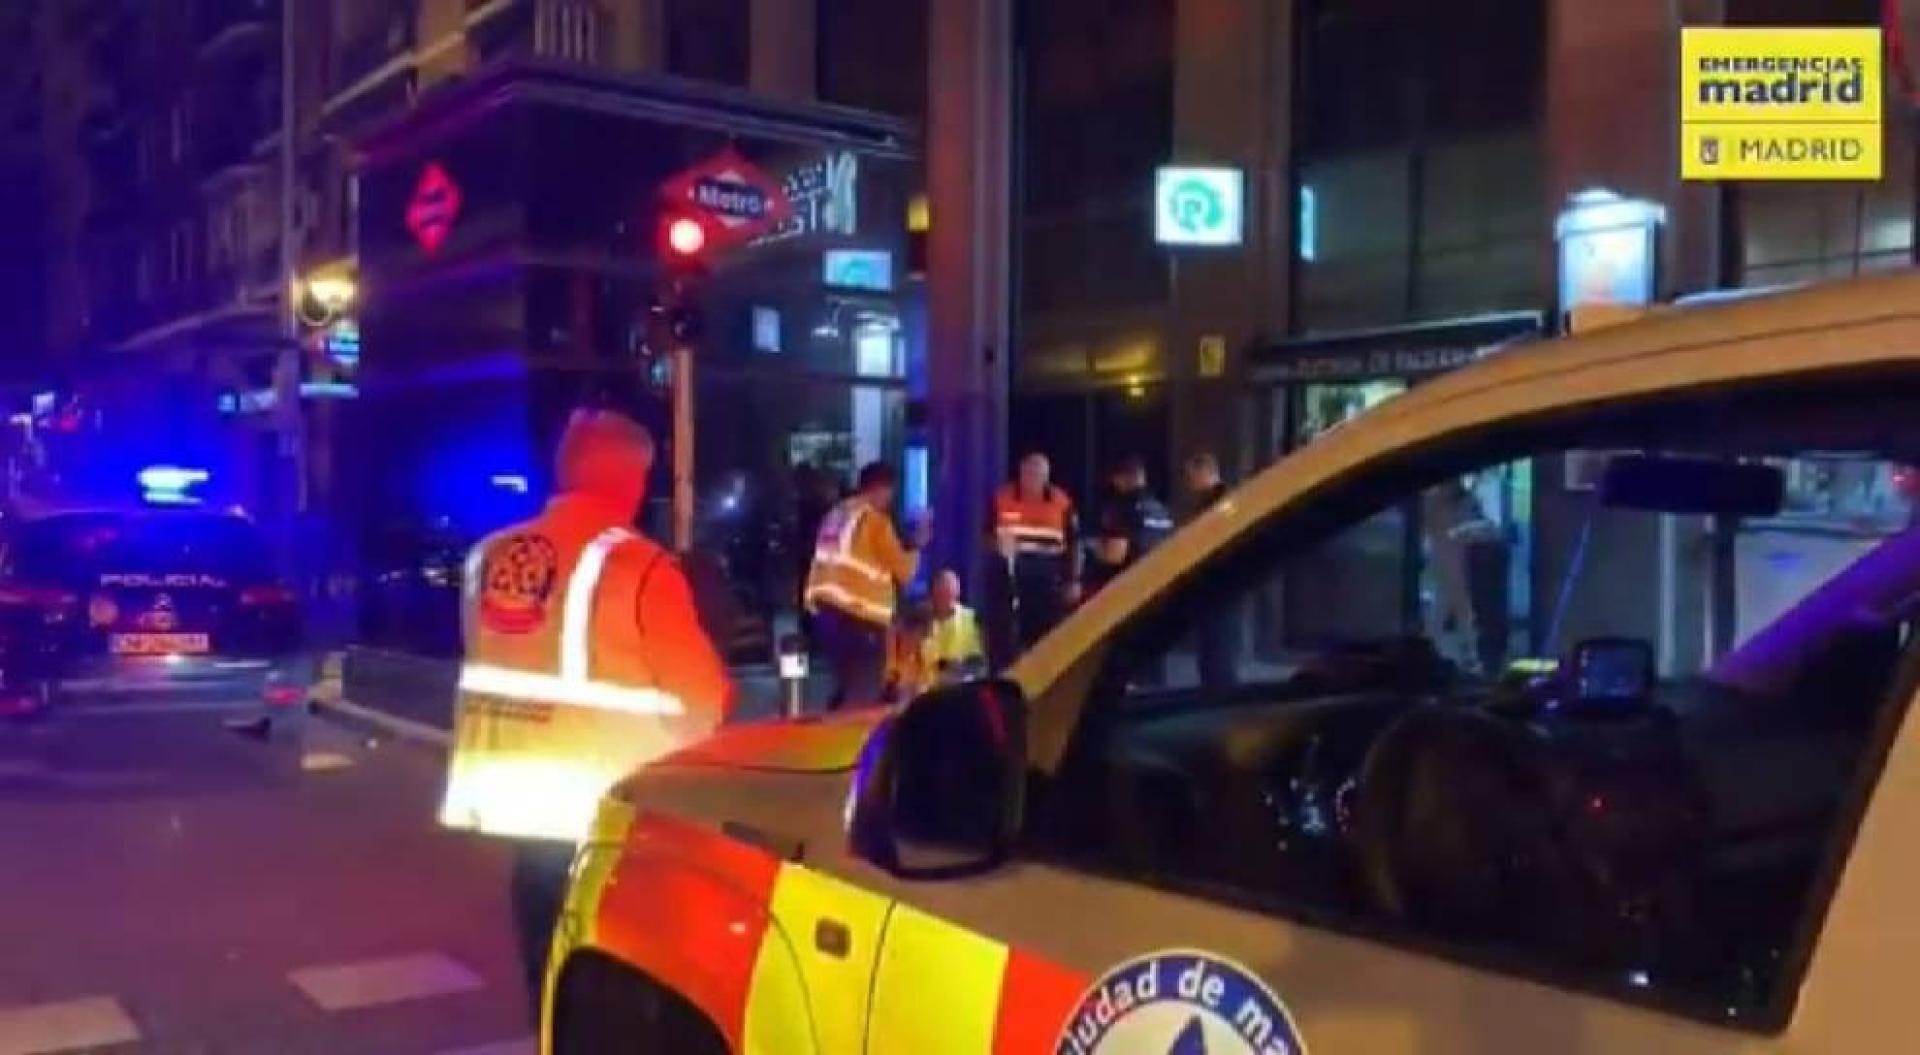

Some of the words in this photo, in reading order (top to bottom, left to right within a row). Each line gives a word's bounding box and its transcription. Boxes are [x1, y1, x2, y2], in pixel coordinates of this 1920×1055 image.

[699, 182, 763, 215] Metro
[100, 573, 228, 588] POLICIA
[1063, 958, 1160, 1055] iudad
[1178, 958, 1225, 1005] de
